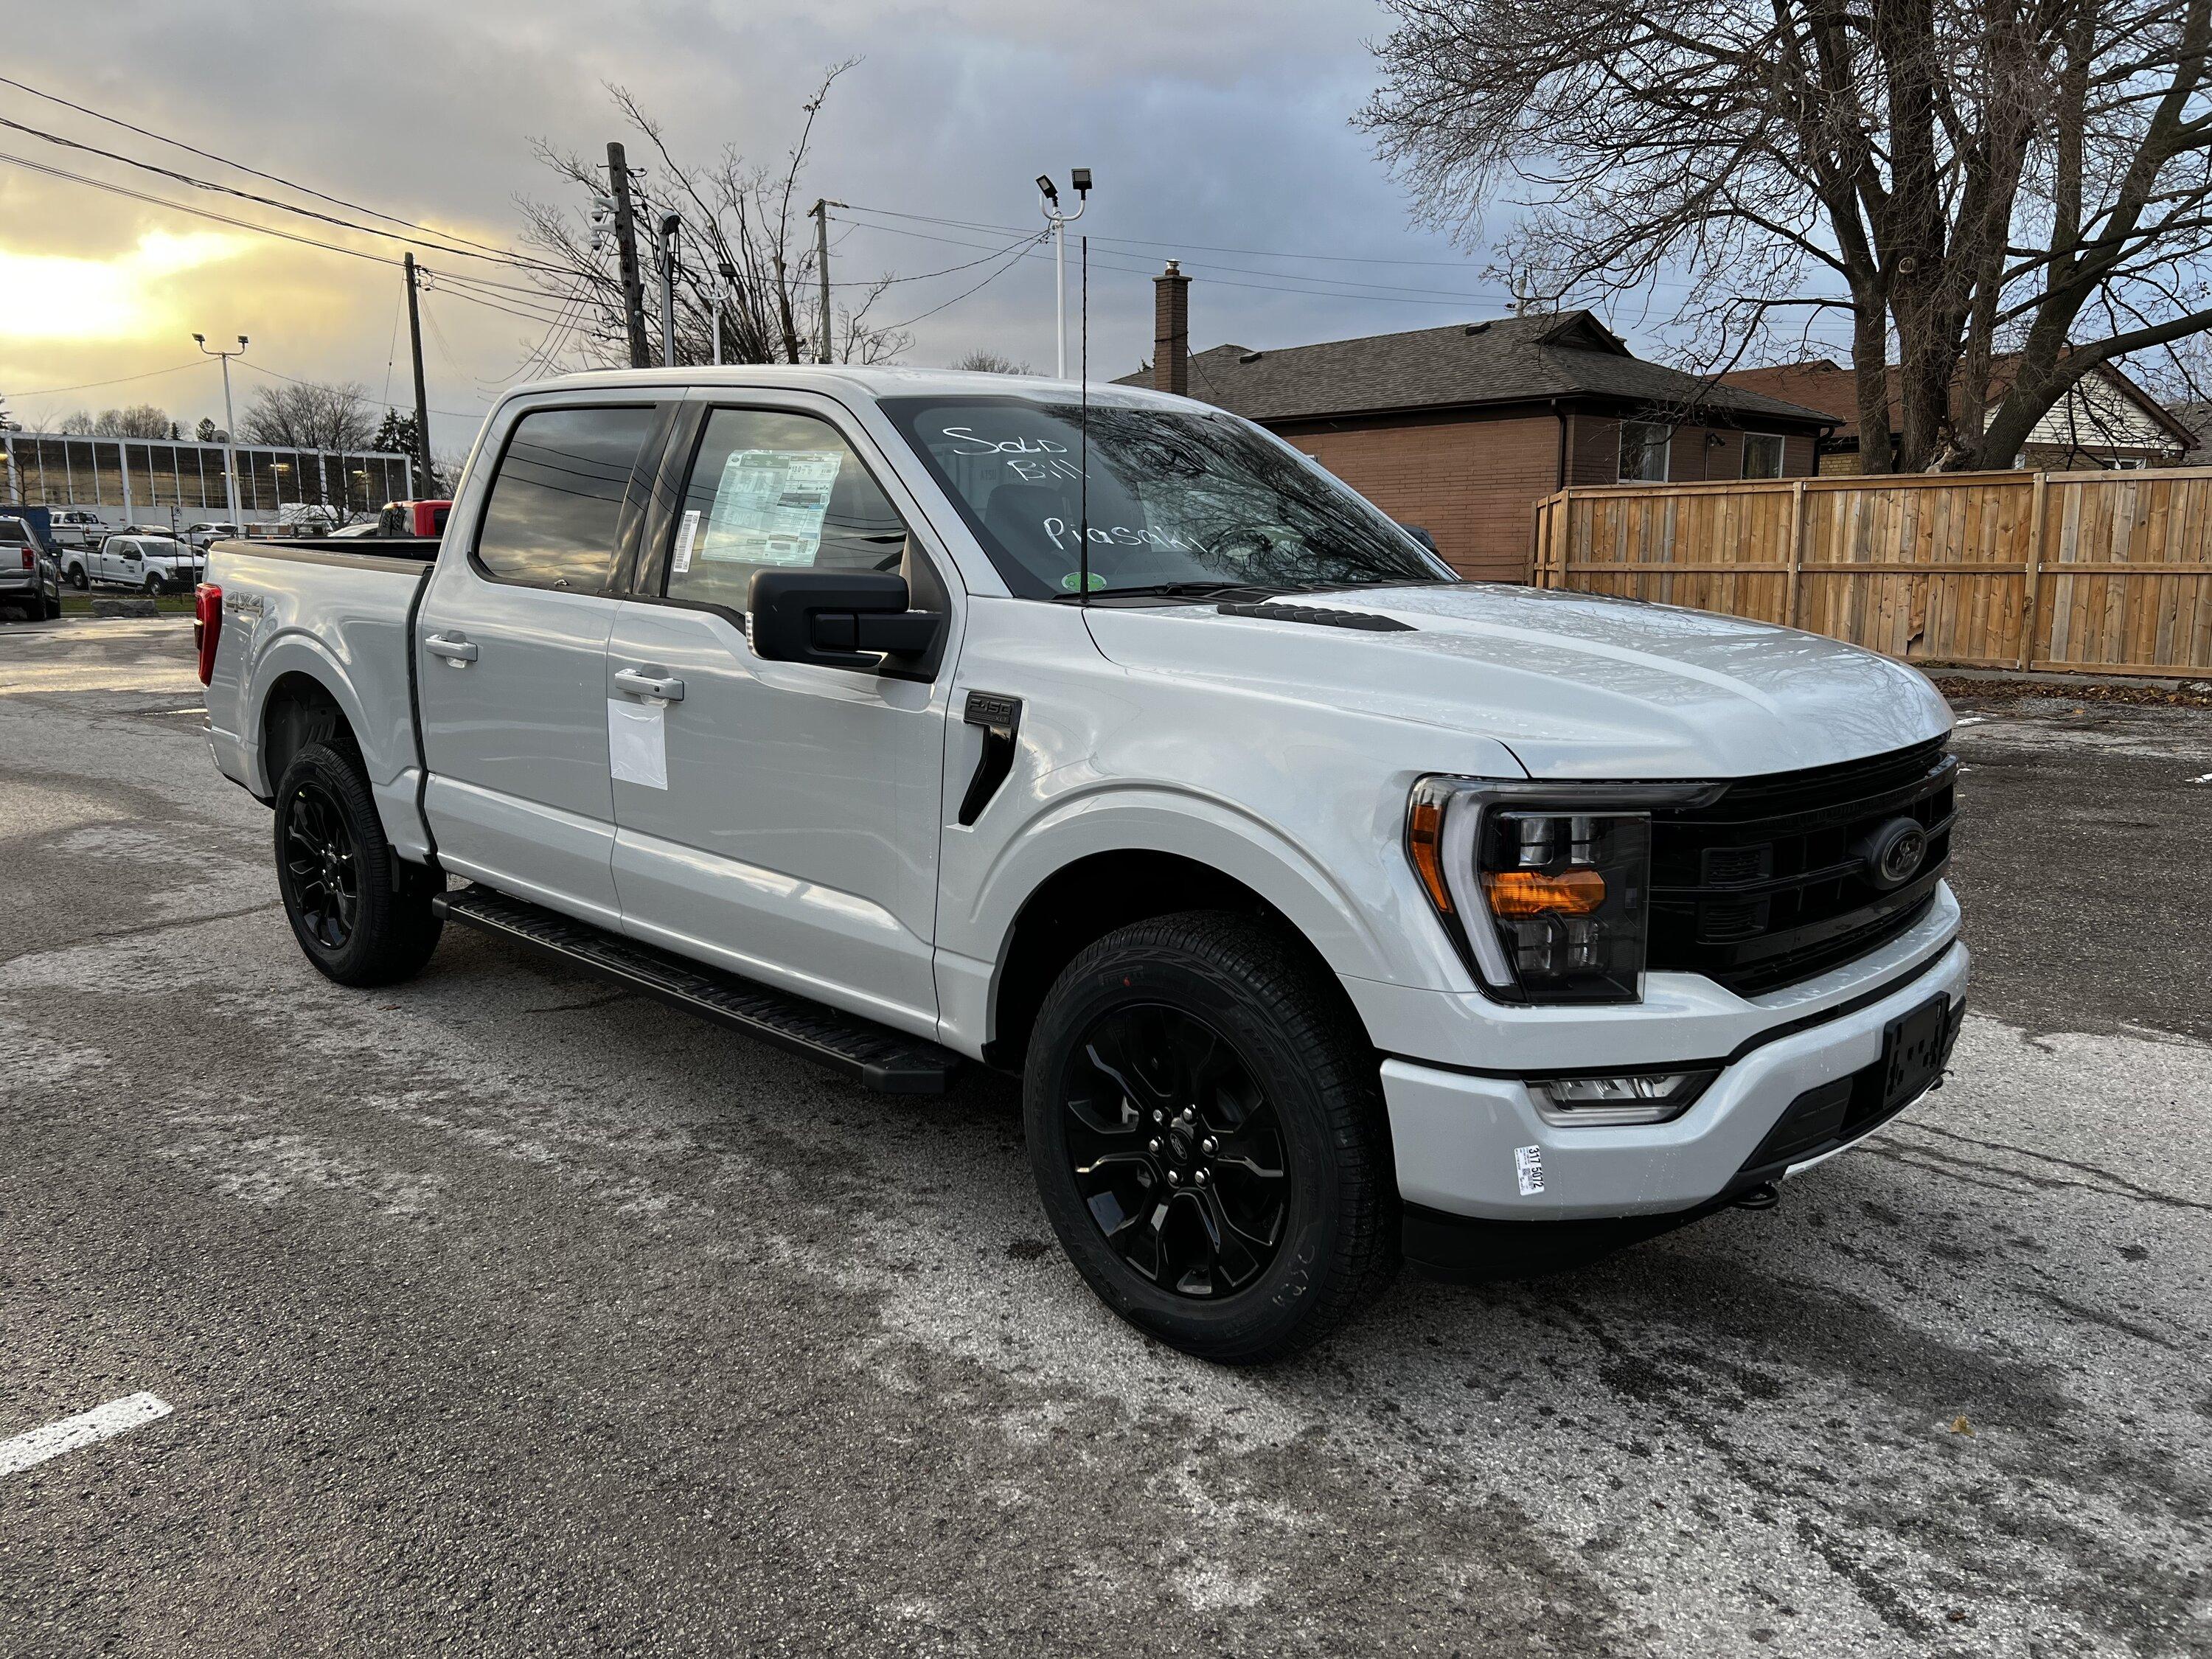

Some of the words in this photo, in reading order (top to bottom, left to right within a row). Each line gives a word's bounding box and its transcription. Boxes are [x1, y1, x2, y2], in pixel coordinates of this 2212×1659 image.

[1006, 459, 1091, 481] Bill
[1528, 1147, 1541, 1164] 317
[1531, 1166, 1545, 1189] 5072
